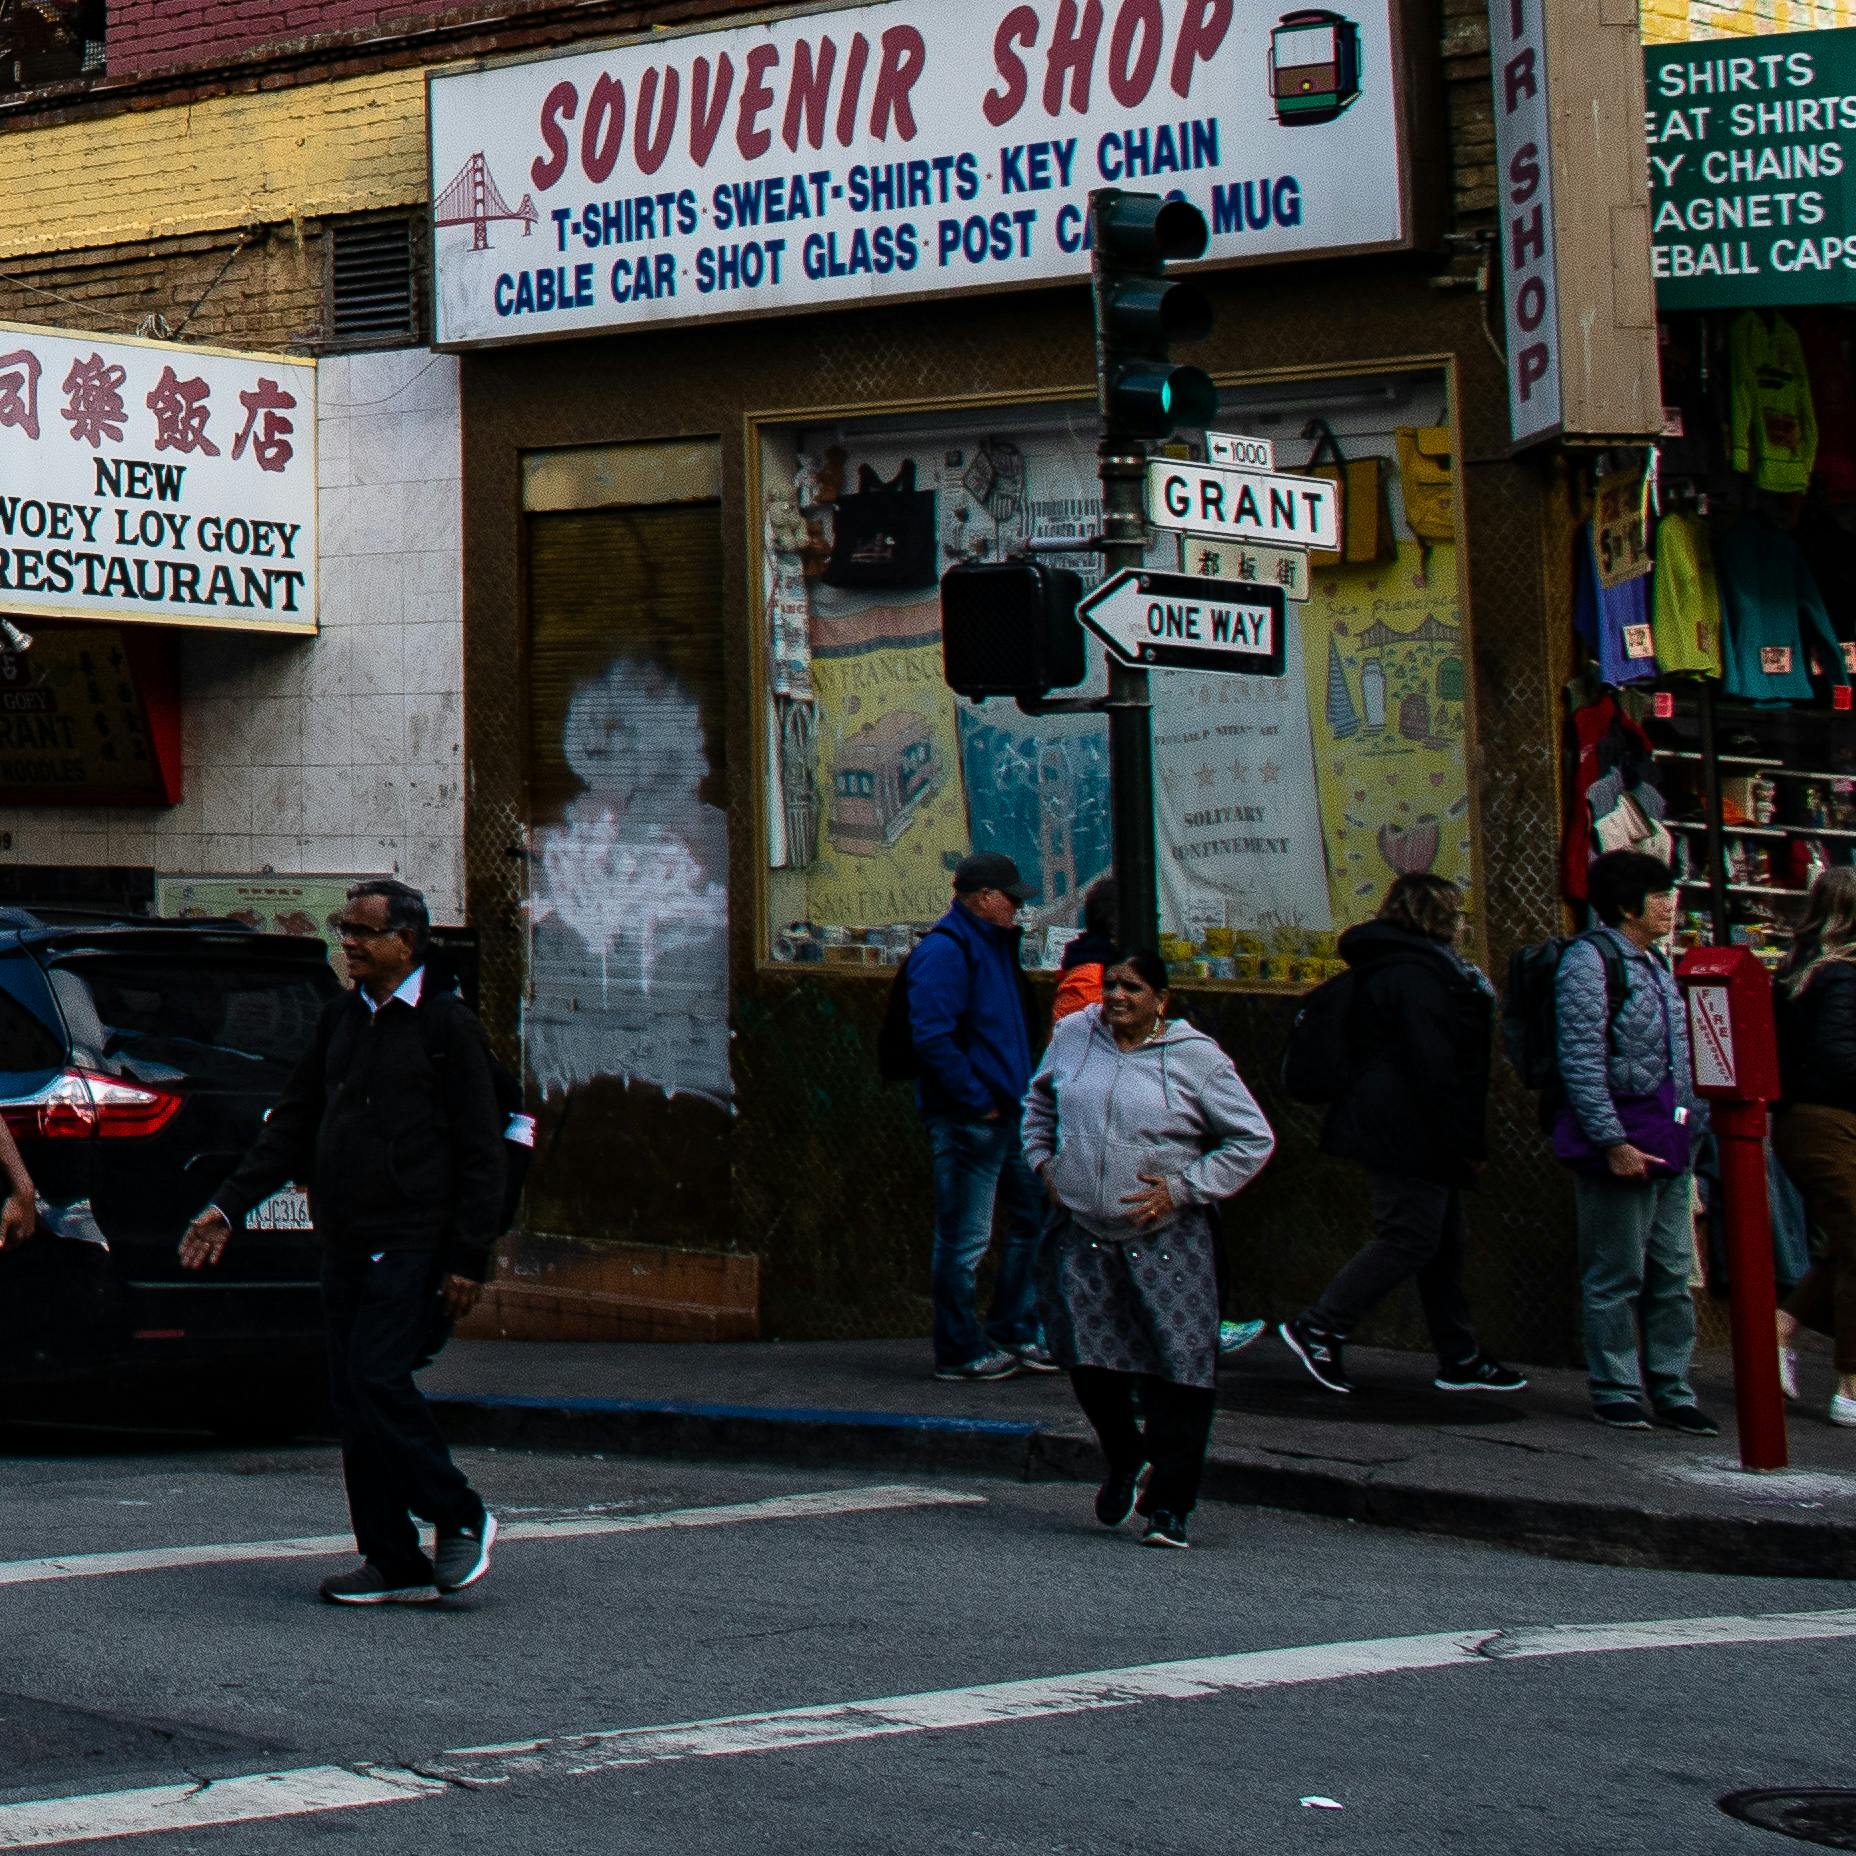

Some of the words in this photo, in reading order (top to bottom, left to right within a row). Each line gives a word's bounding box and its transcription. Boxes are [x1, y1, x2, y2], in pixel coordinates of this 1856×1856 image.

[531, 24, 926, 193] SOUVENIR
[552, 187, 699, 253] T-SHIRTS
[712, 152, 978, 232] SWEAT-SHIRTS
[1000, 140, 1078, 195] KEY
[1097, 119, 1221, 182] CHAIN
[1701, 141, 1844, 185] CHAINS
[494, 261, 596, 318] CABLE
[610, 250, 678, 302] CAR
[695, 240, 785, 294] SHOT
[802, 224, 920, 282] GLASS
[938, 209, 1037, 267] POST
[1211, 177, 1302, 235] MUG
[1769, 235, 1856, 273] CAPS
[1507, 143, 1549, 403] SHOP
[1231, 441, 1268, 465] 1000
[93, 458, 184, 502] NEW
[1164, 475, 1323, 534] GRANT
[115, 510, 193, 551] LOY
[197, 517, 302, 560] GOEY
[1147, 602, 1201, 639] ONE
[1211, 608, 1264, 646] WAY
